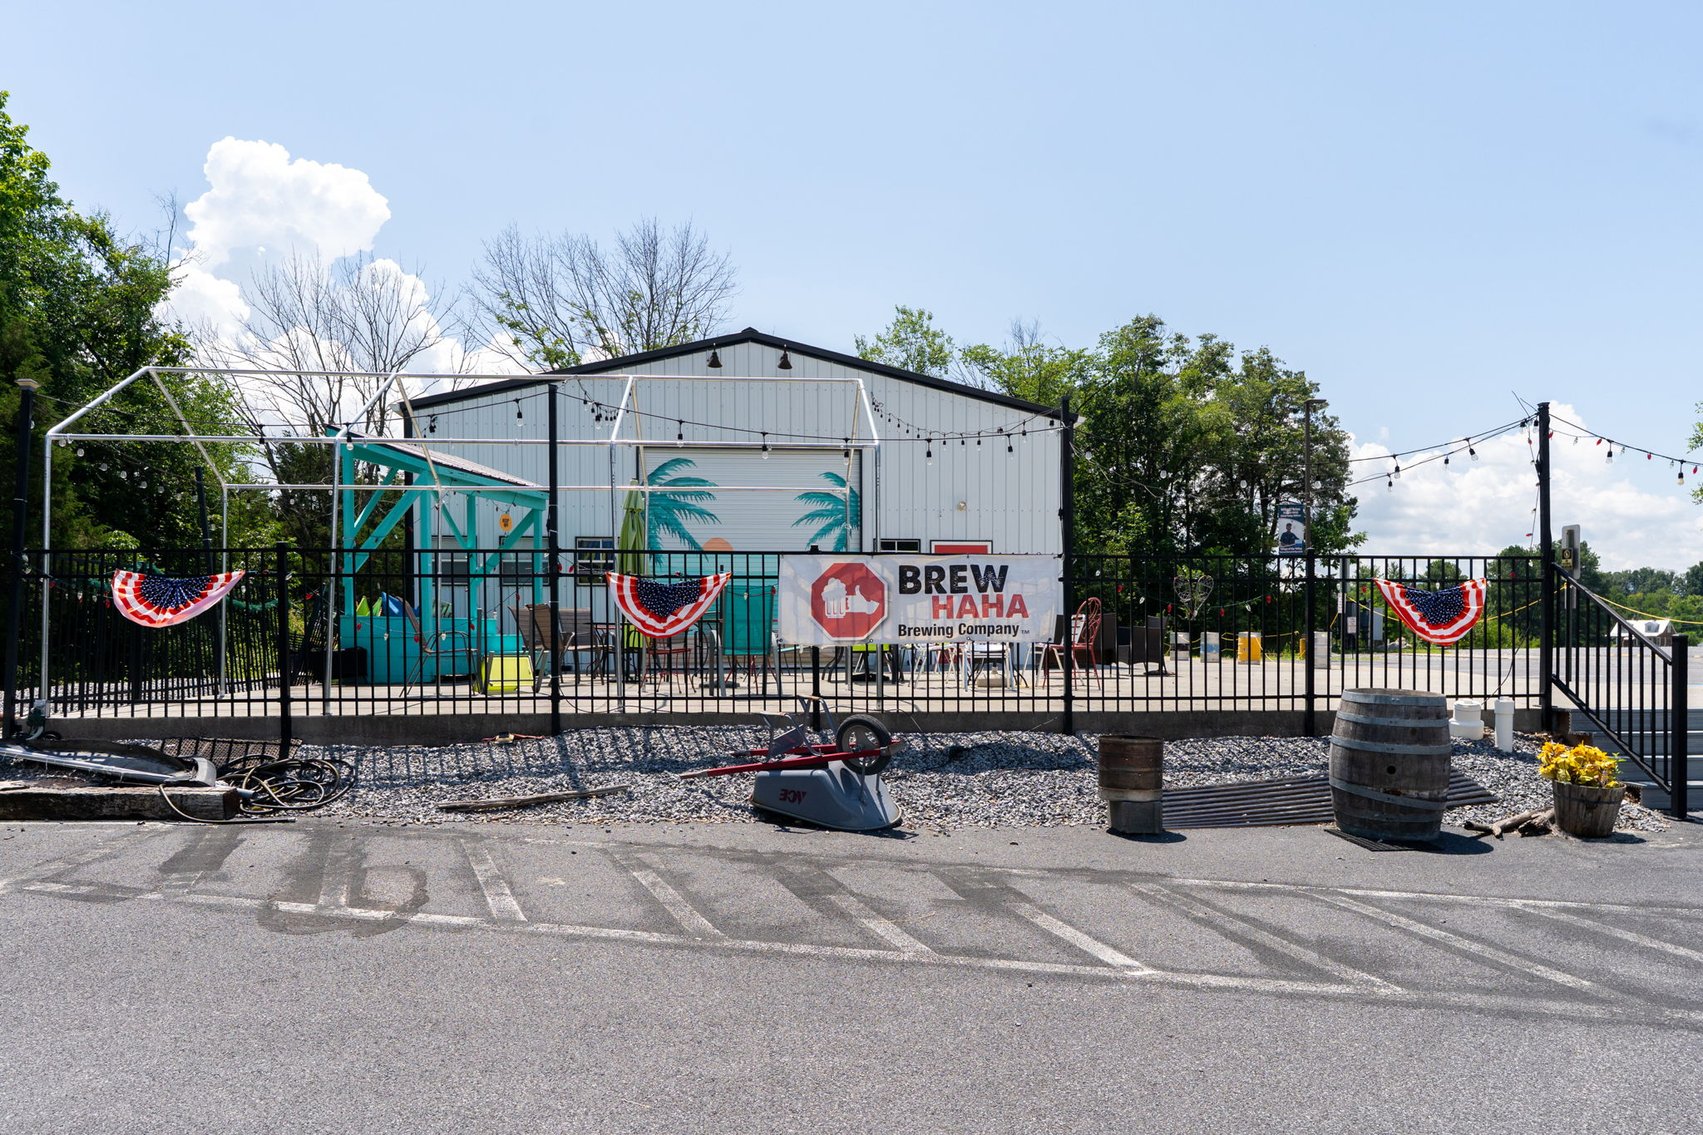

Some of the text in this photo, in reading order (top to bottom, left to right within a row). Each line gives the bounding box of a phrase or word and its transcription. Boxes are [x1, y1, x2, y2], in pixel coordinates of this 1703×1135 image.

[899, 565, 1009, 594] BREW
[932, 594, 1029, 619] HAHA
[898, 624, 954, 638] Brewing
[958, 623, 1020, 637] Company
[779, 788, 807, 804] ACE
